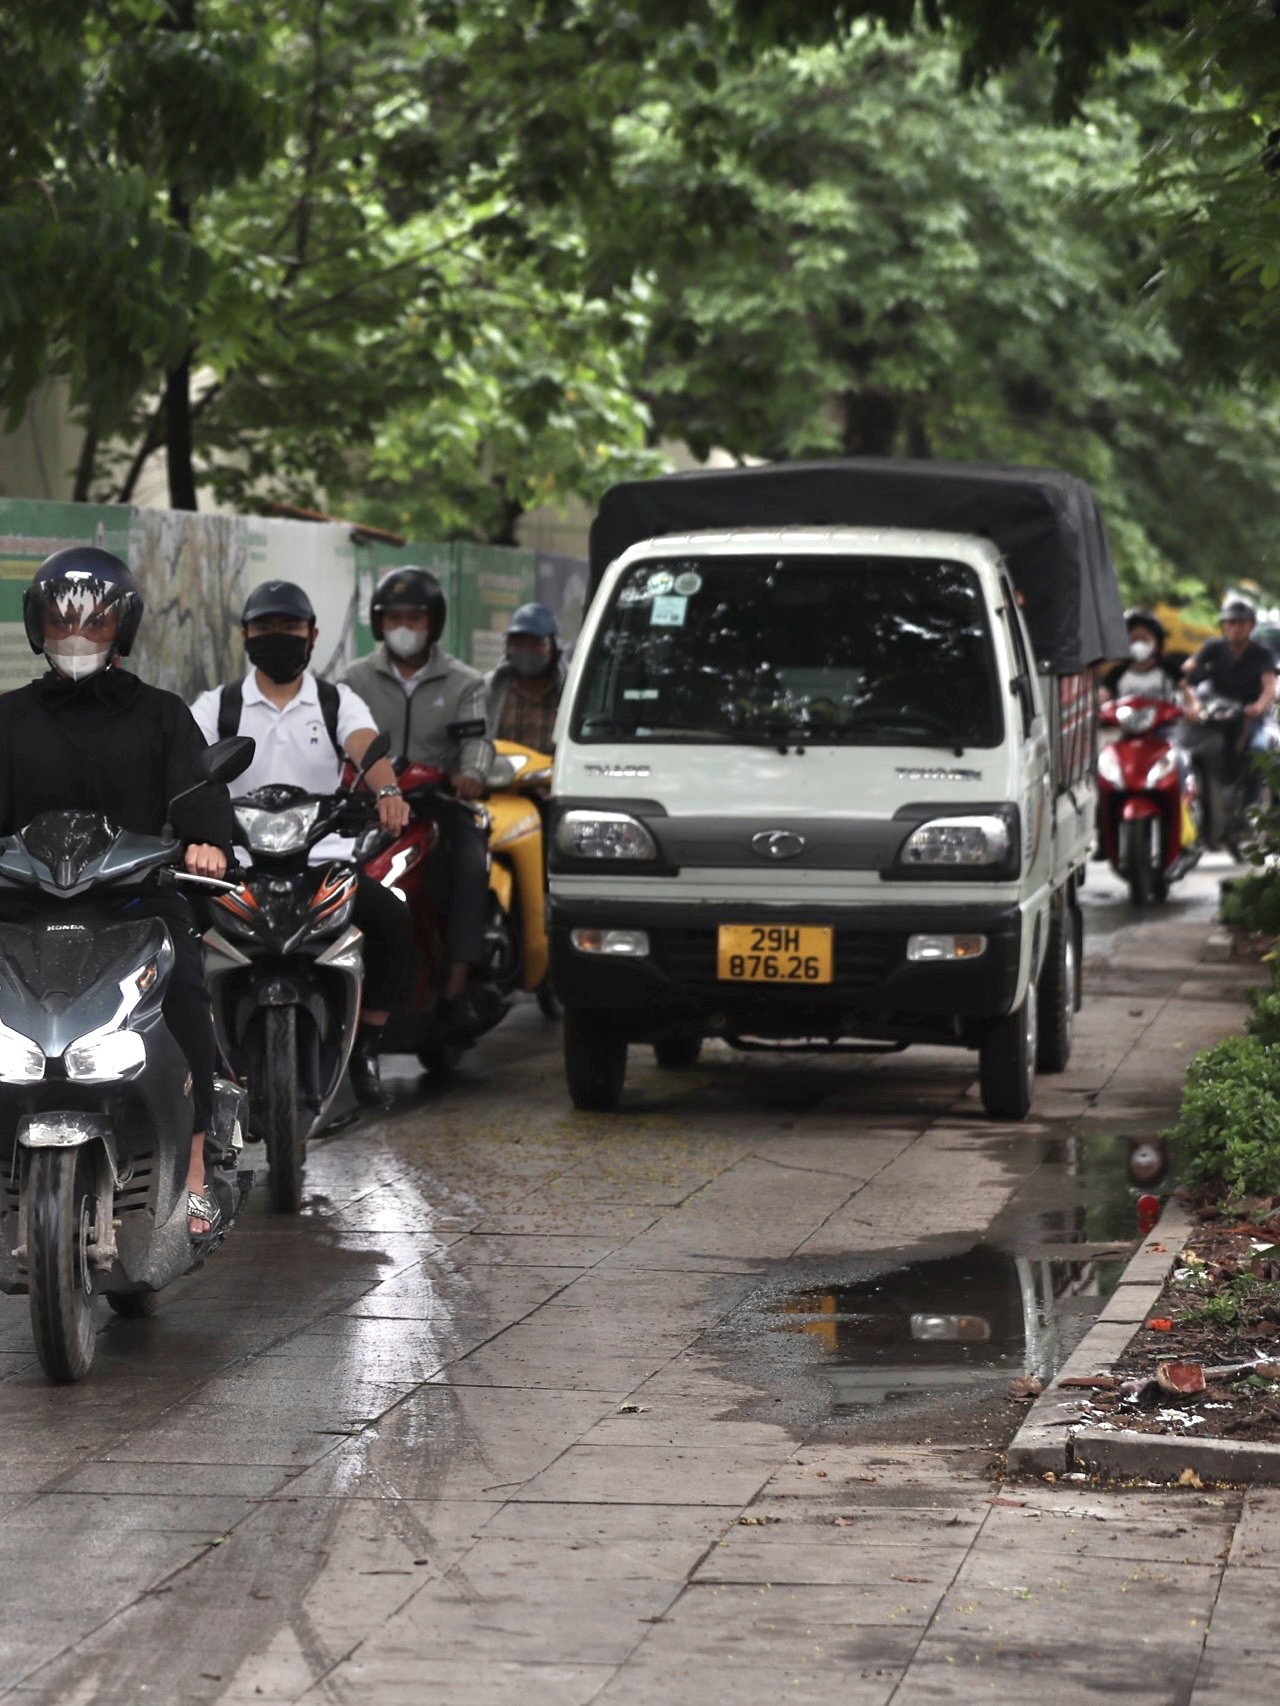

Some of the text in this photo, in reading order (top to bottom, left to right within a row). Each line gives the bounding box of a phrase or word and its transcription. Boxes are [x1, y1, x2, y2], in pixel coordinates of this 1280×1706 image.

[46, 924, 86, 932] HONDA
[750, 927, 800, 953] 29H
[729, 954, 820, 980] 876.26
